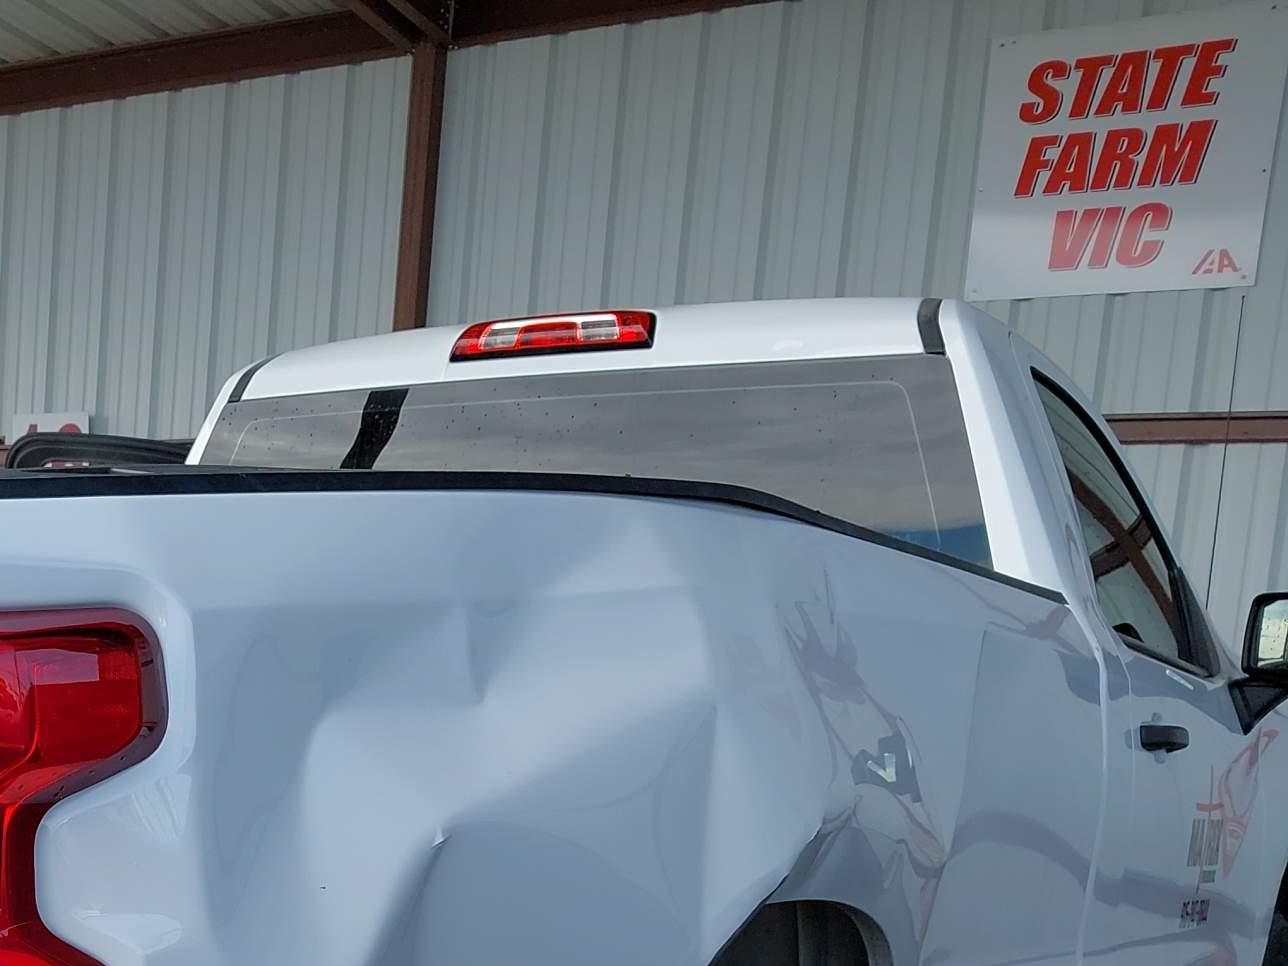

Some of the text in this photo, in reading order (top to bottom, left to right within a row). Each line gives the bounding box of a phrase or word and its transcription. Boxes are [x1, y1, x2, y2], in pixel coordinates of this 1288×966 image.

[1018, 38, 1239, 125] STATE
[1014, 119, 1218, 198] FARM
[1048, 202, 1173, 271] VIC
